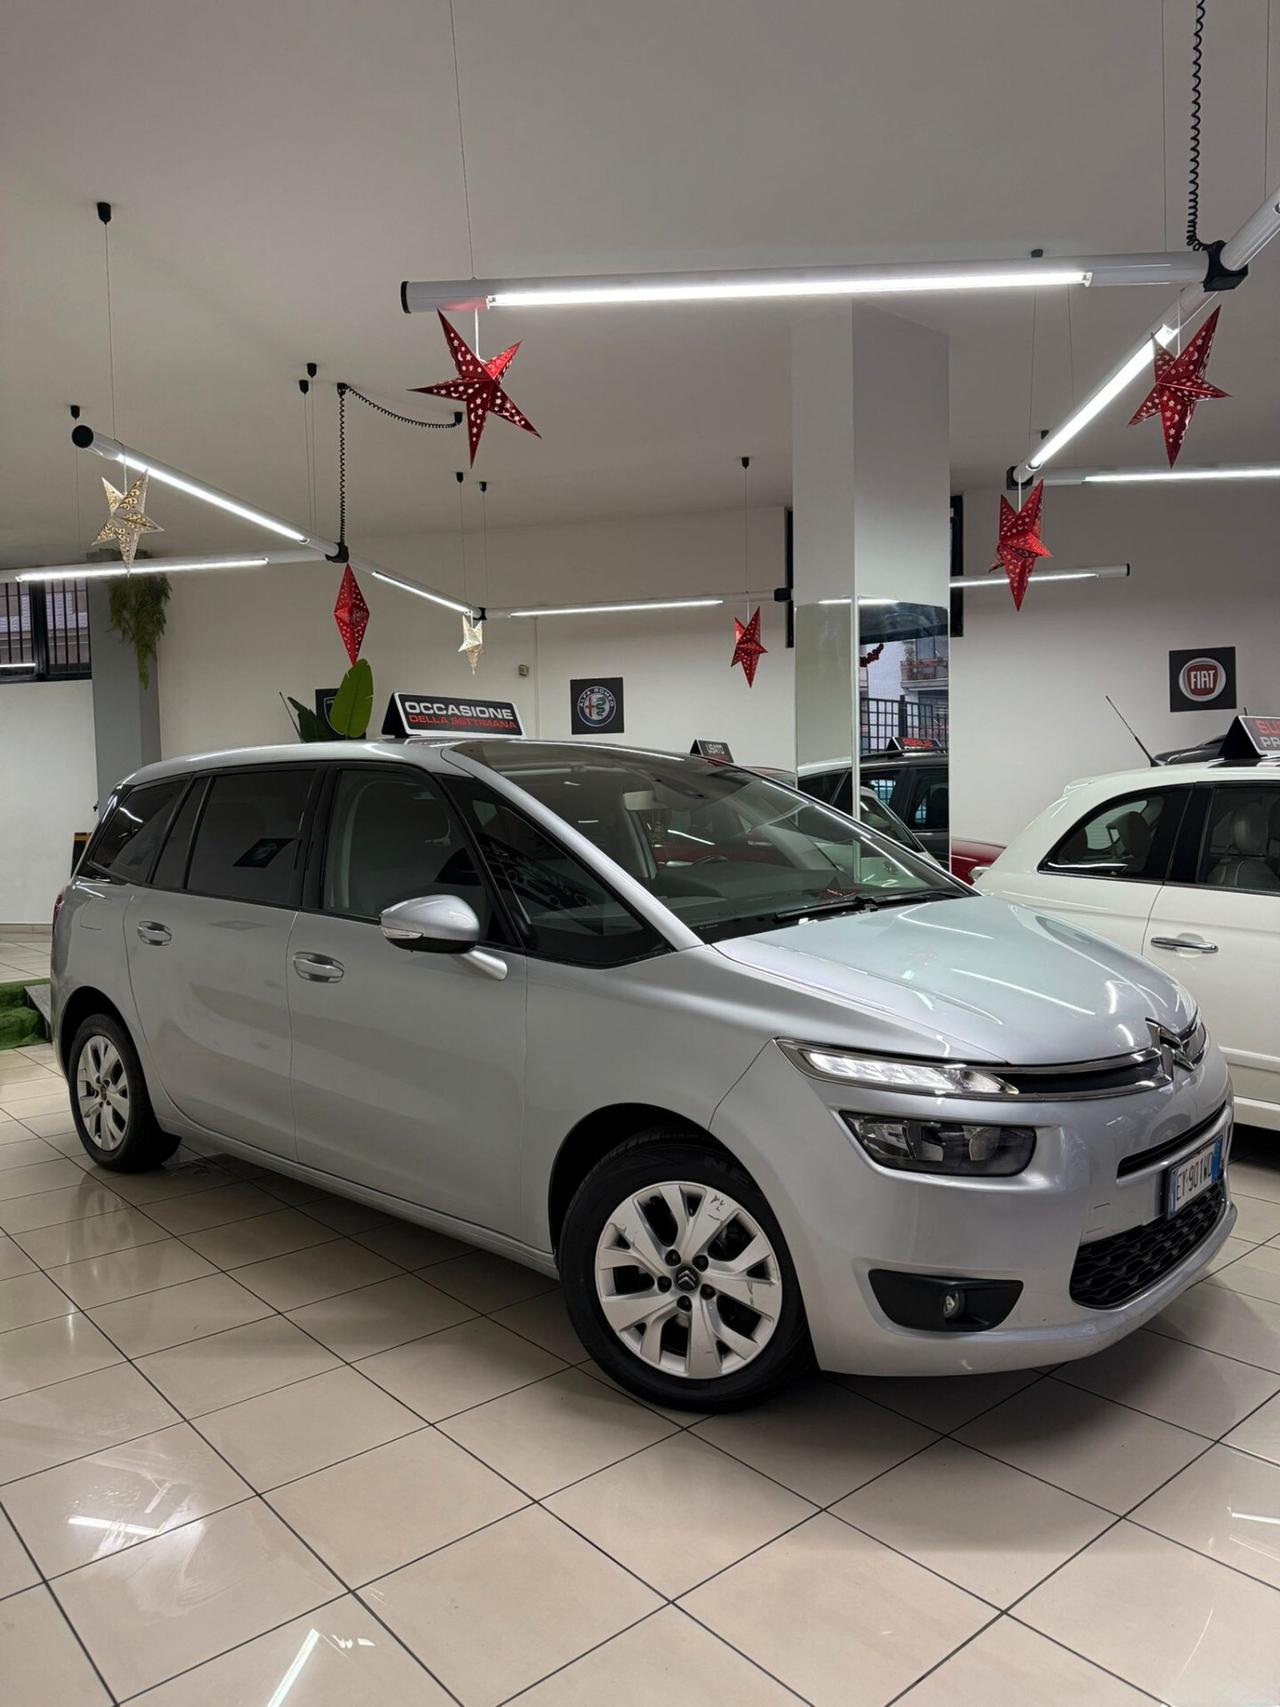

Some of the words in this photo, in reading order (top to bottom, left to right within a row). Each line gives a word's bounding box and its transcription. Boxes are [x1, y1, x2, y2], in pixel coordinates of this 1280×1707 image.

[1190, 670, 1215, 689] FIAT
[404, 701, 514, 720] OCCASIONE
[408, 714, 448, 725] DELLA
